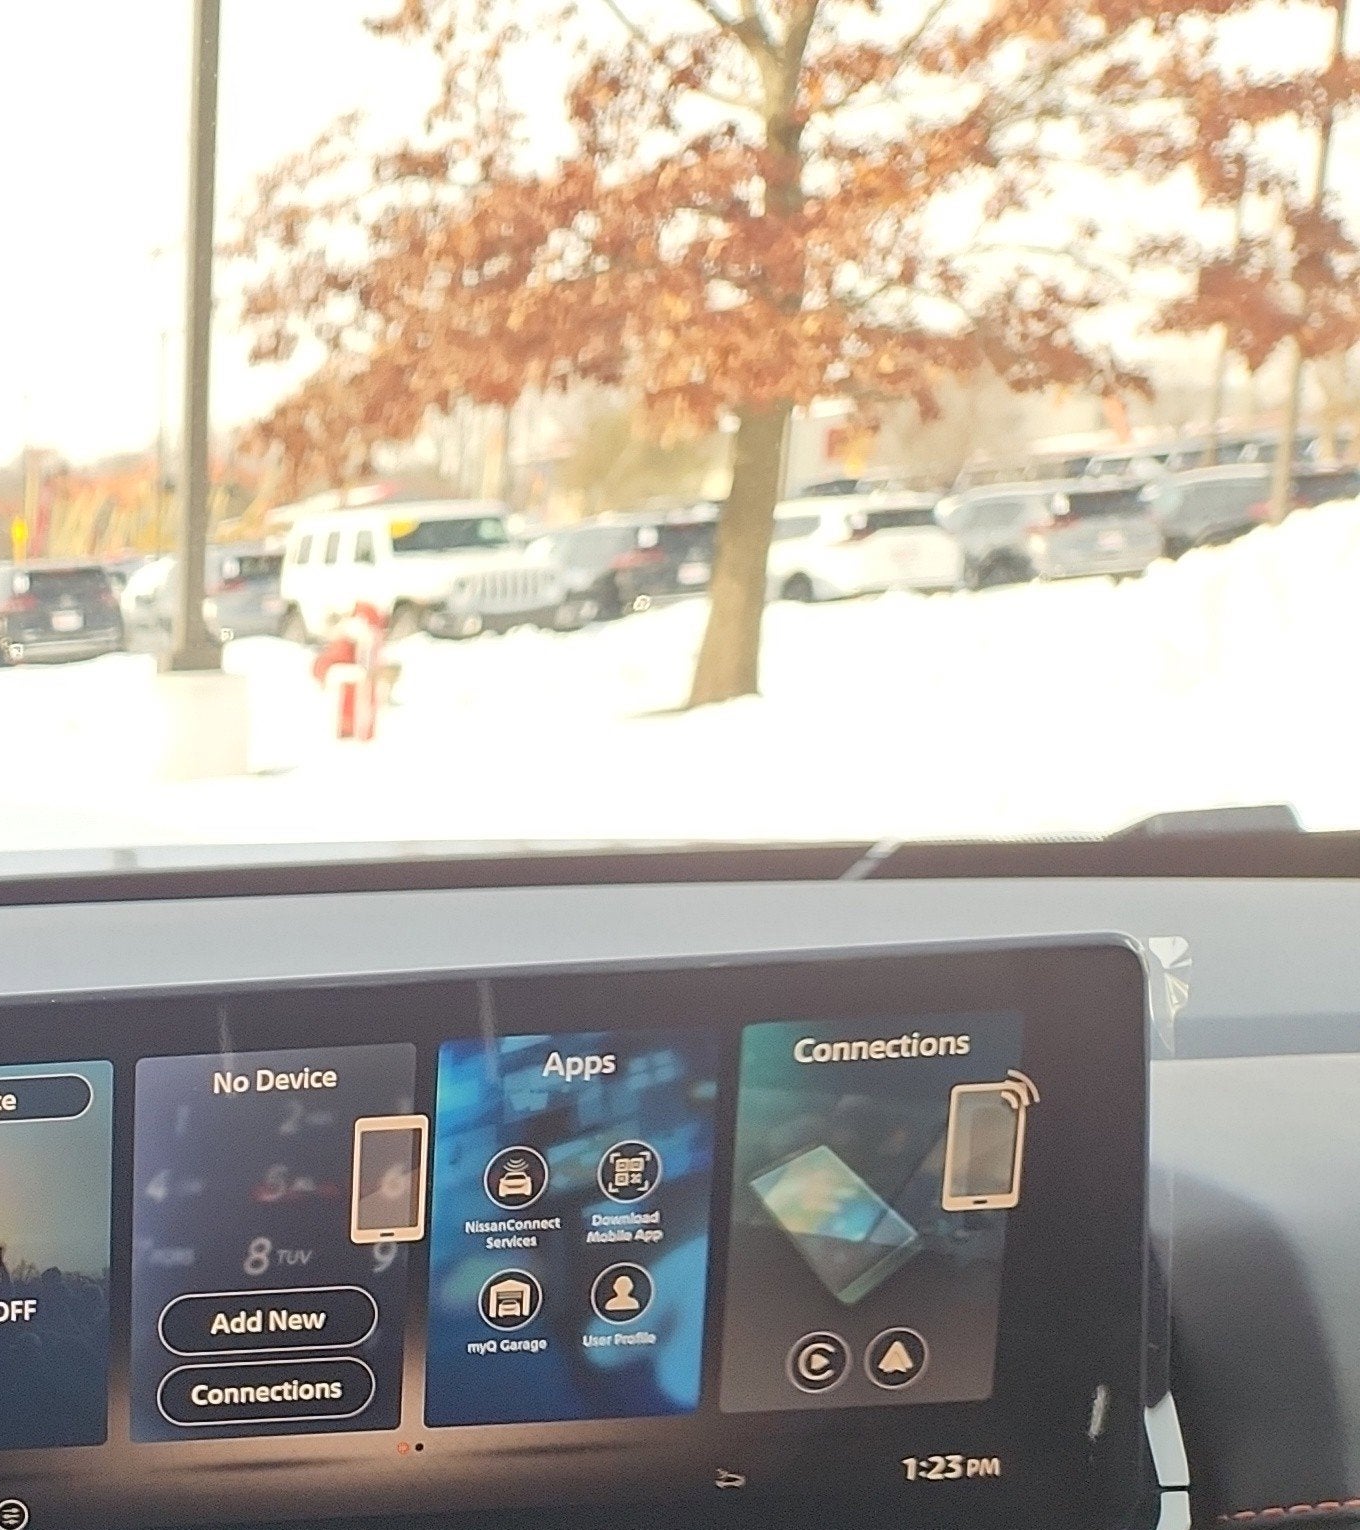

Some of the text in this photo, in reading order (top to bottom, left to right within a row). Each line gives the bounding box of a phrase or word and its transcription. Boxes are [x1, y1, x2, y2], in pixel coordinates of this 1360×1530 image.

[794, 1031, 971, 1063] Connections
[542, 1051, 616, 1082] Apps
[213, 1067, 338, 1094] No Device
[465, 1217, 561, 1234] NissanConnect
[591, 1210, 661, 1227] Download
[486, 1235, 538, 1250] Services
[586, 1229, 664, 1245] Mobile App
[210, 1310, 327, 1335] Add New
[467, 1338, 548, 1356] myQ Garage
[582, 1331, 657, 1348] User Profile
[191, 1379, 343, 1406] Connections
